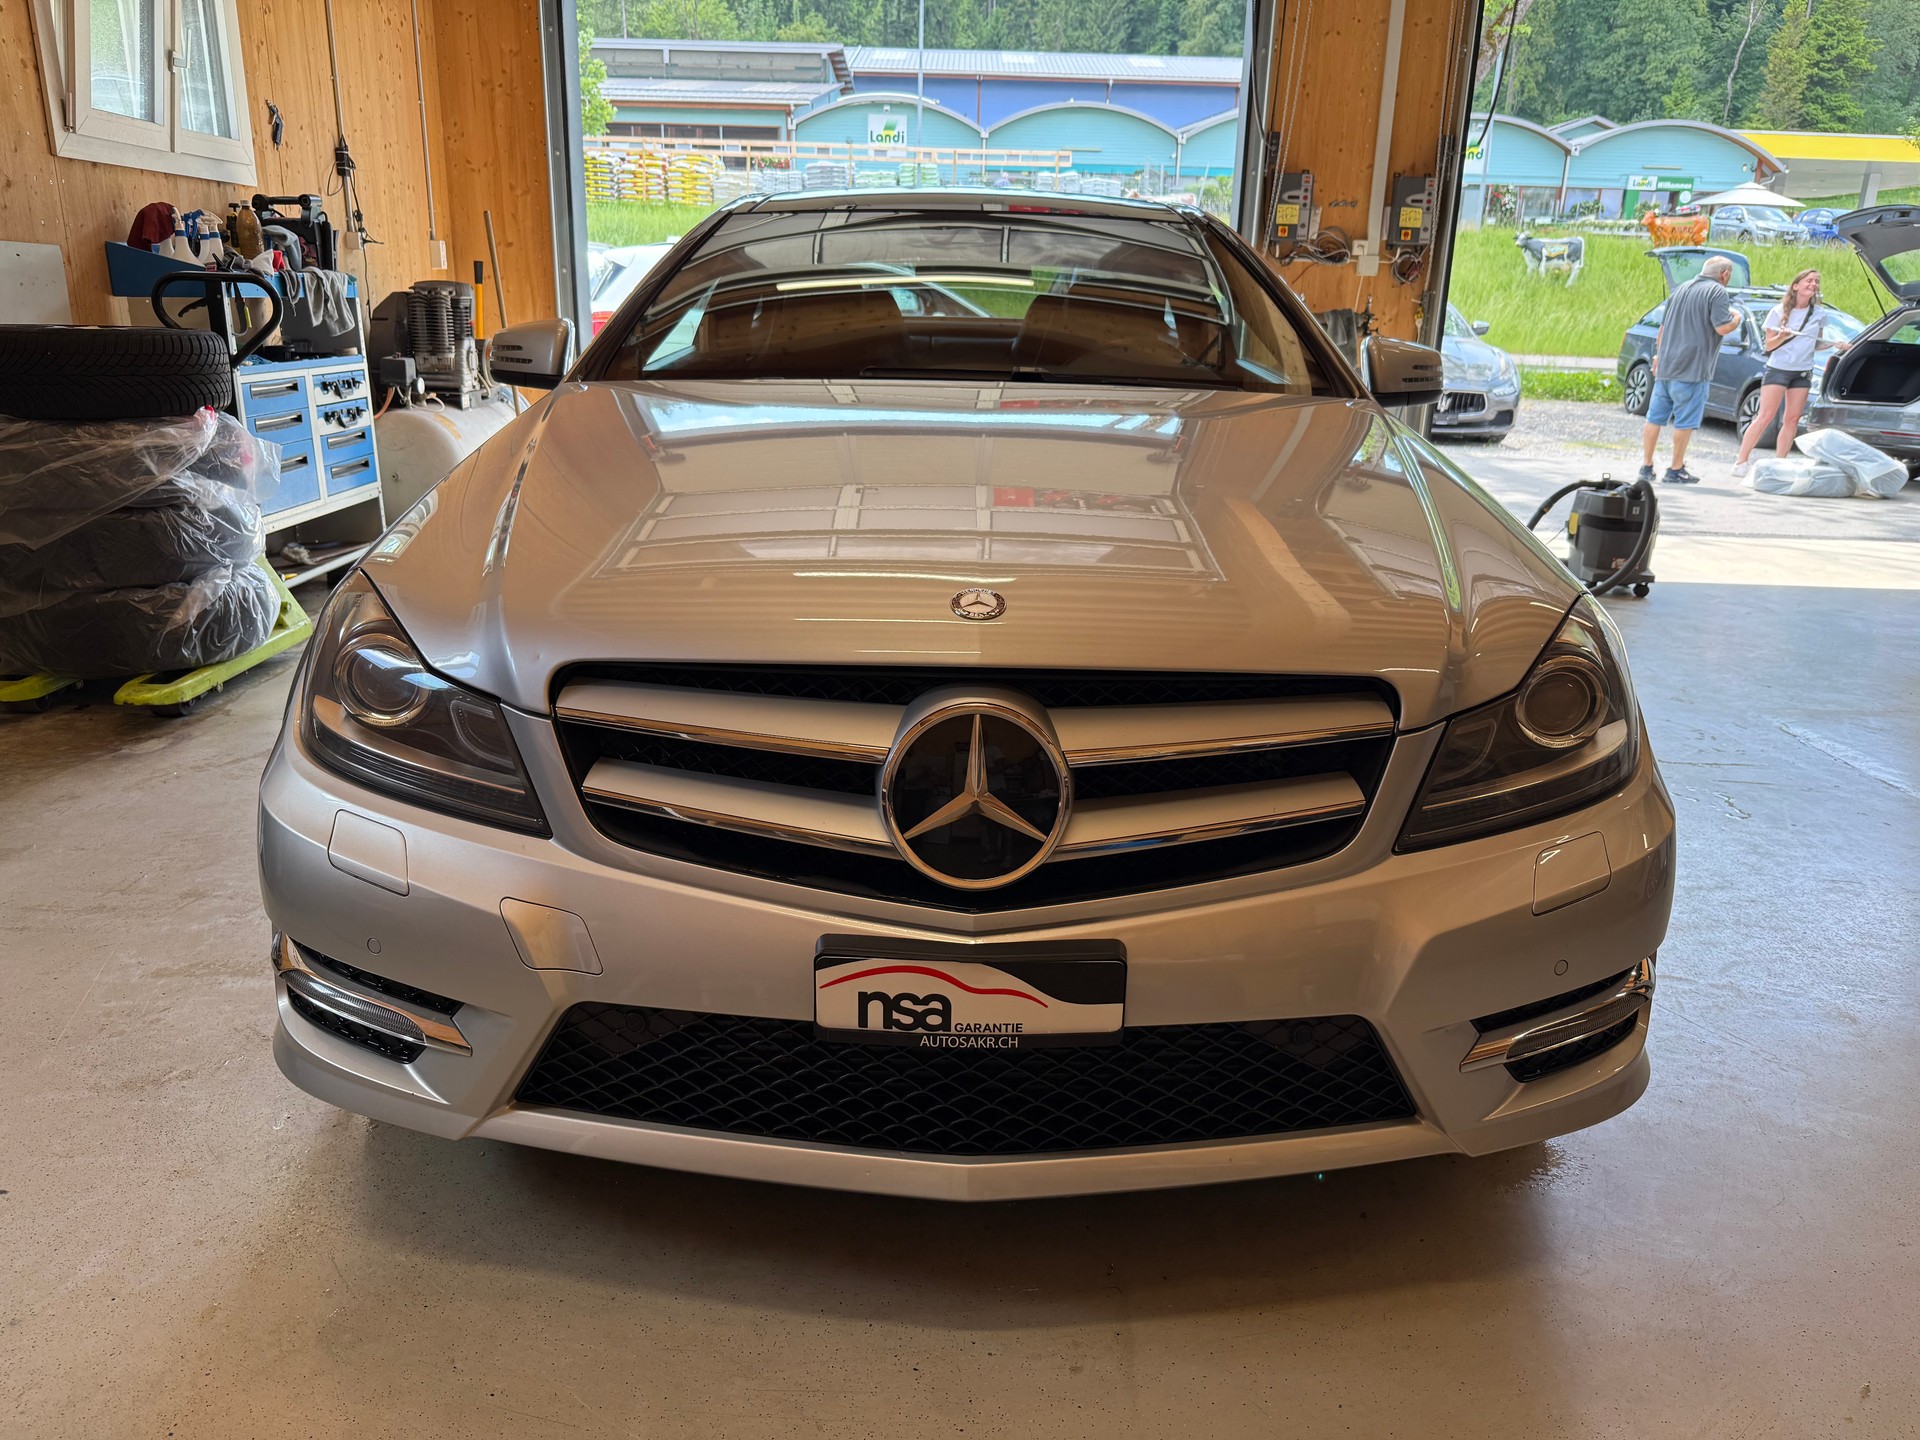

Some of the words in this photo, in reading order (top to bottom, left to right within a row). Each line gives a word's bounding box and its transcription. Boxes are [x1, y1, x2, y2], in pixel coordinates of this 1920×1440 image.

[870, 130, 905, 144] Landi
[857, 990, 952, 1032] nsa
[954, 1022, 1024, 1034] GARANTIE
[919, 1034, 1019, 1050] AUTOSAKR.CH
